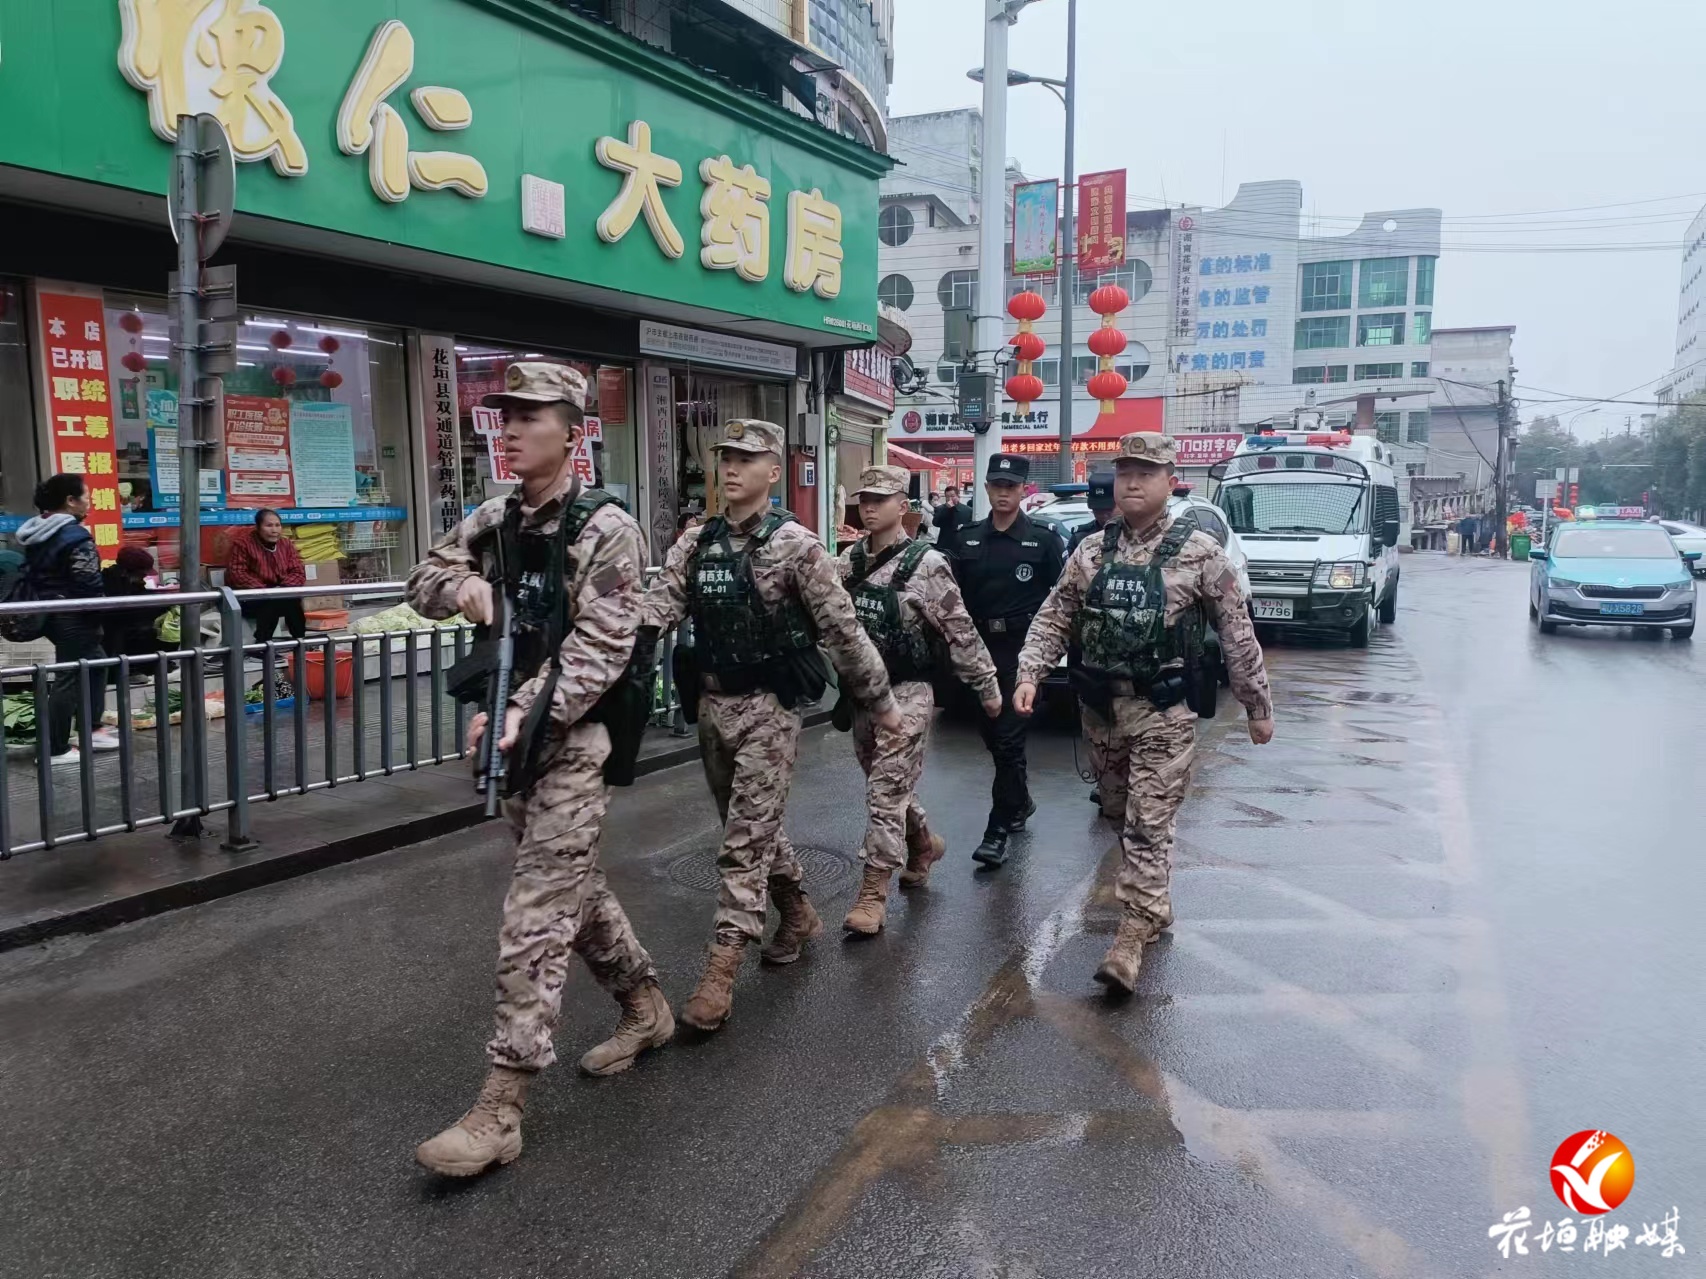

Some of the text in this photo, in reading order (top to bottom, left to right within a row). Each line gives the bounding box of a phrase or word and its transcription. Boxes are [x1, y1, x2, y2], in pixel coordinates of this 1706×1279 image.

[593, 119, 844, 300] 大药房
[50, 346, 104, 371] 已开通
[698, 569, 735, 584] 湘西支队
[702, 585, 727, 594] 24-01
[1105, 578, 1145, 593] 湘西支队
[1254, 606, 1291, 617] 17796
